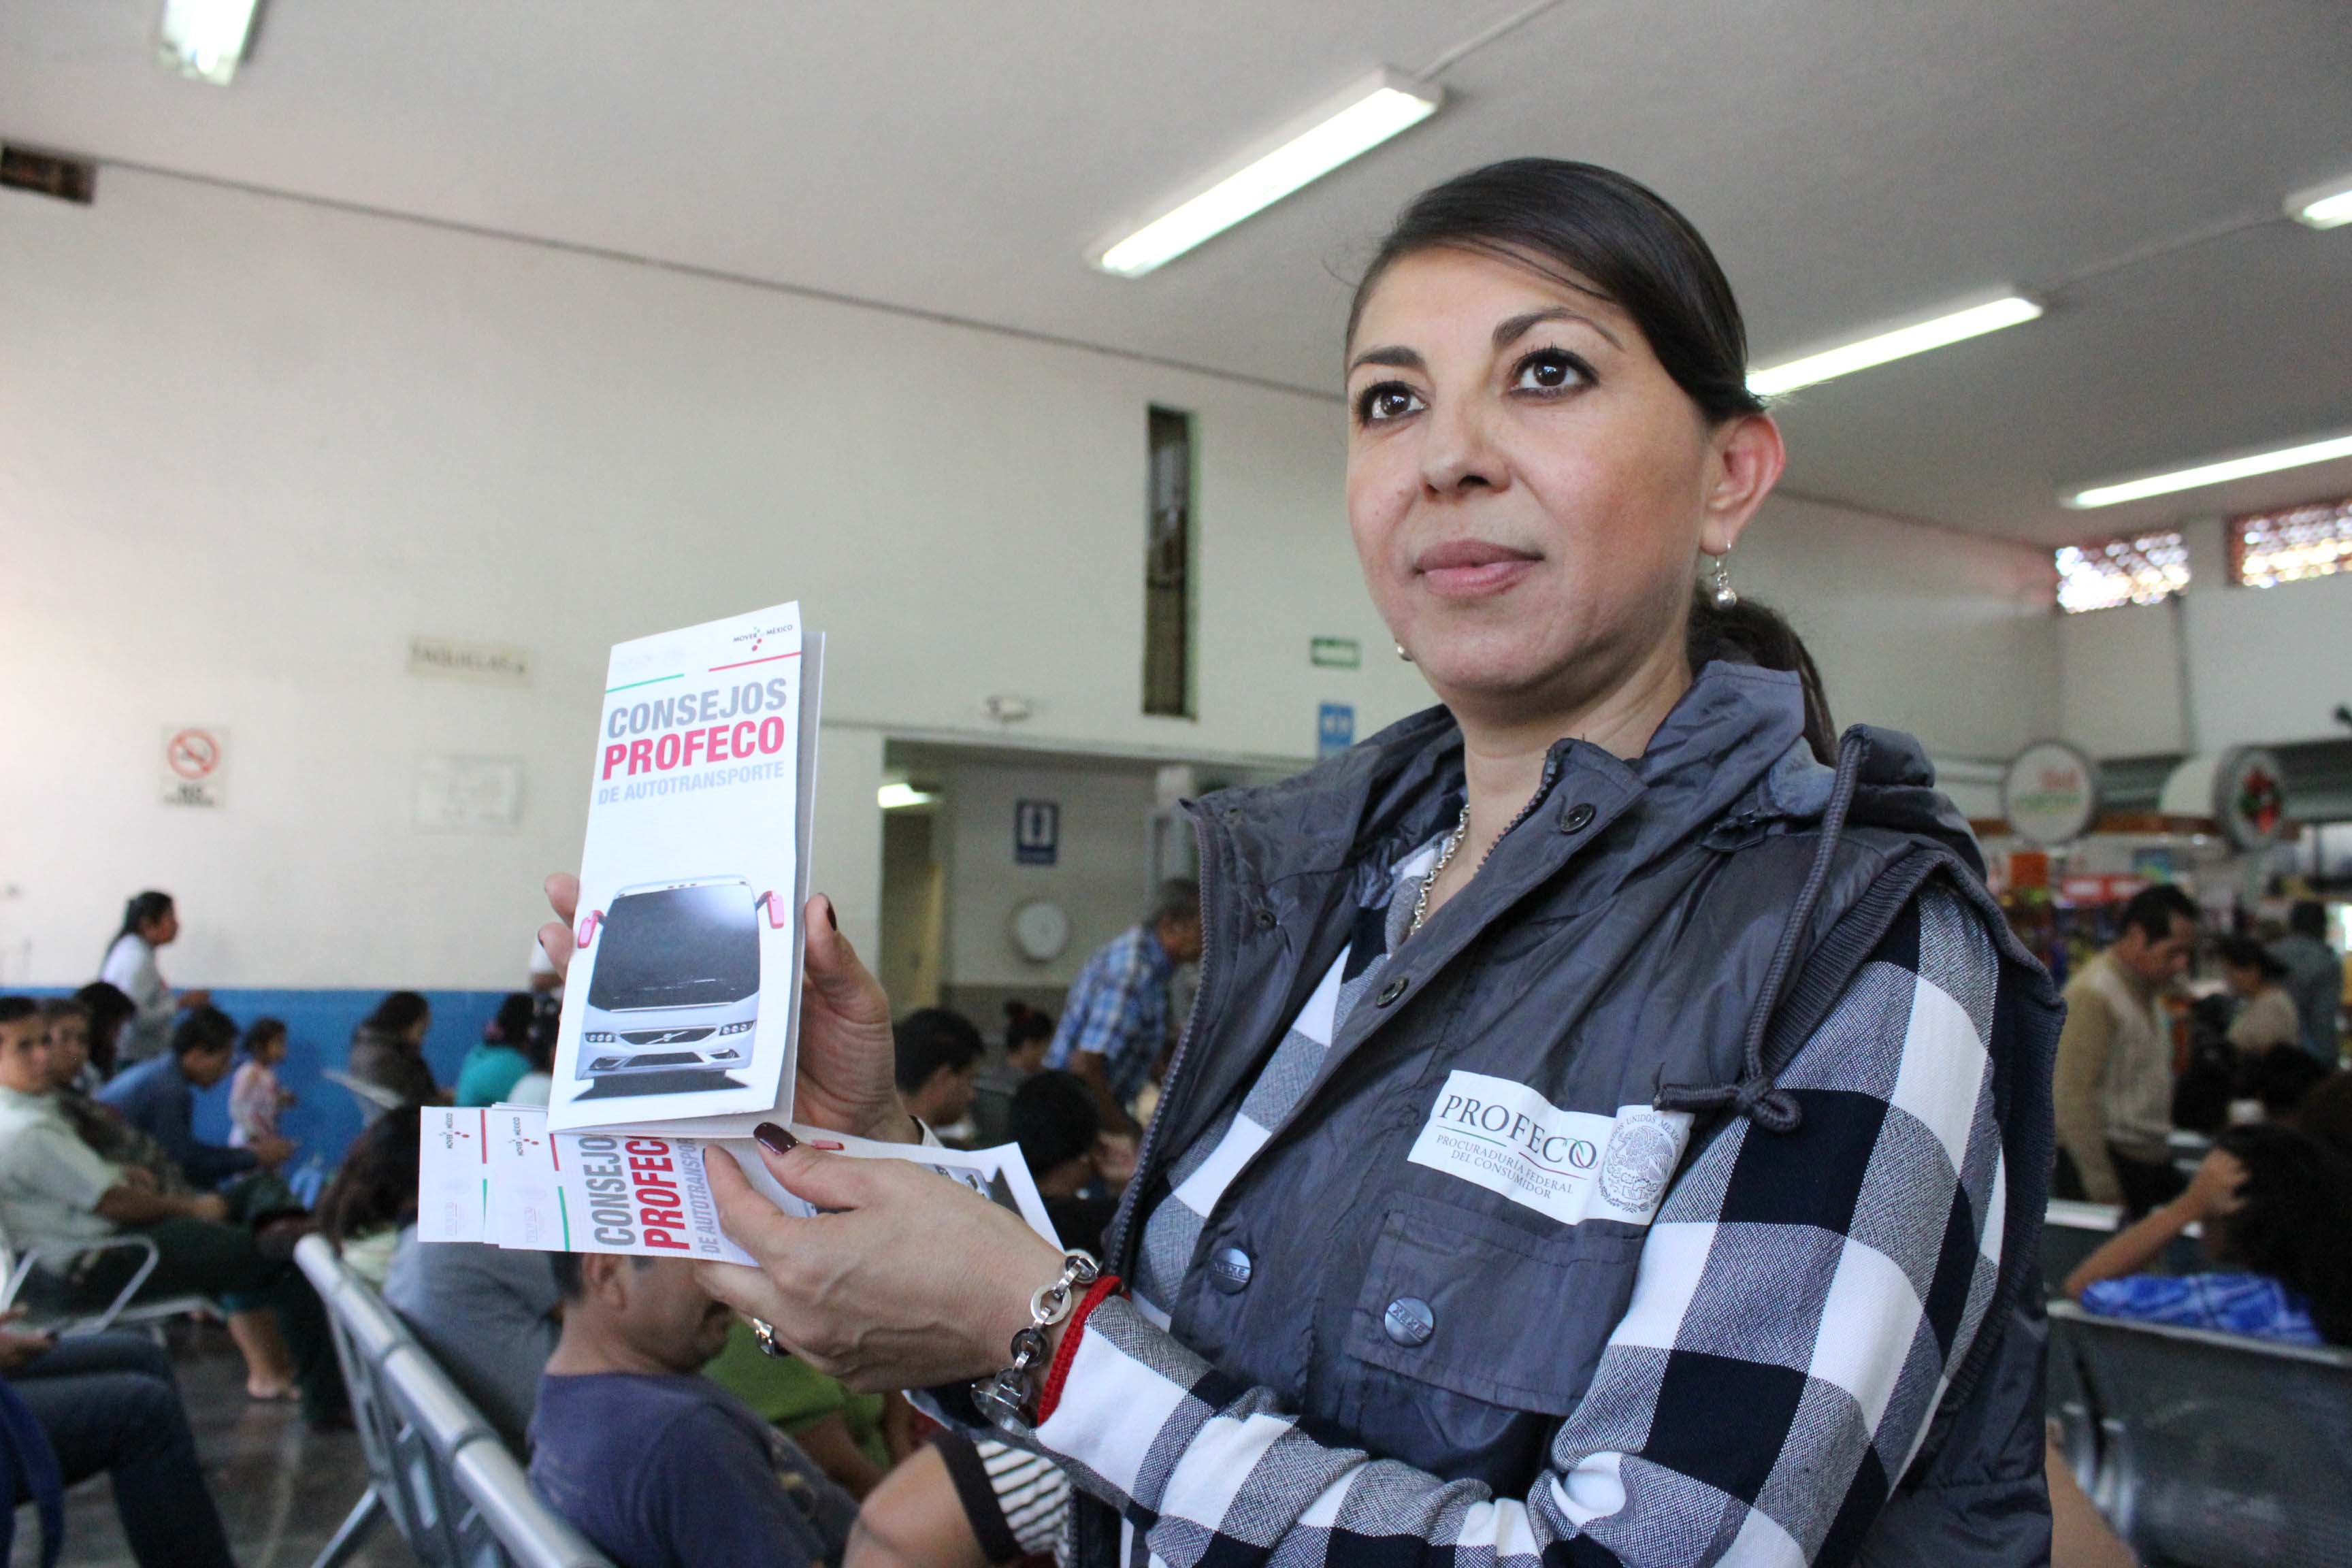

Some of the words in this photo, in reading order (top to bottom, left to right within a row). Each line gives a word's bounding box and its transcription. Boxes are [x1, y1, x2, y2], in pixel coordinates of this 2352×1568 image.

[734, 632, 757, 642] MOVER
[607, 678, 787, 739] CONSEJOS
[602, 716, 785, 781] PROFECO
[598, 785, 620, 806] DE
[623, 760, 785, 802] AUTOTRANSPORTE
[1437, 1094, 1598, 1170] PROFECO
[1626, 1113, 1656, 1126] UNIDOS
[578, 1135, 636, 1247] CONSEJO
[625, 1136, 691, 1251] PROFEC
[1437, 1134, 1524, 1174] PROCURADURÍA
[1525, 1169, 1573, 1194] FEDERAL
[1450, 1149, 1471, 1164] DEL
[1473, 1156, 1552, 1199] CONSUMIDOR
[698, 1237, 721, 1254] DE
